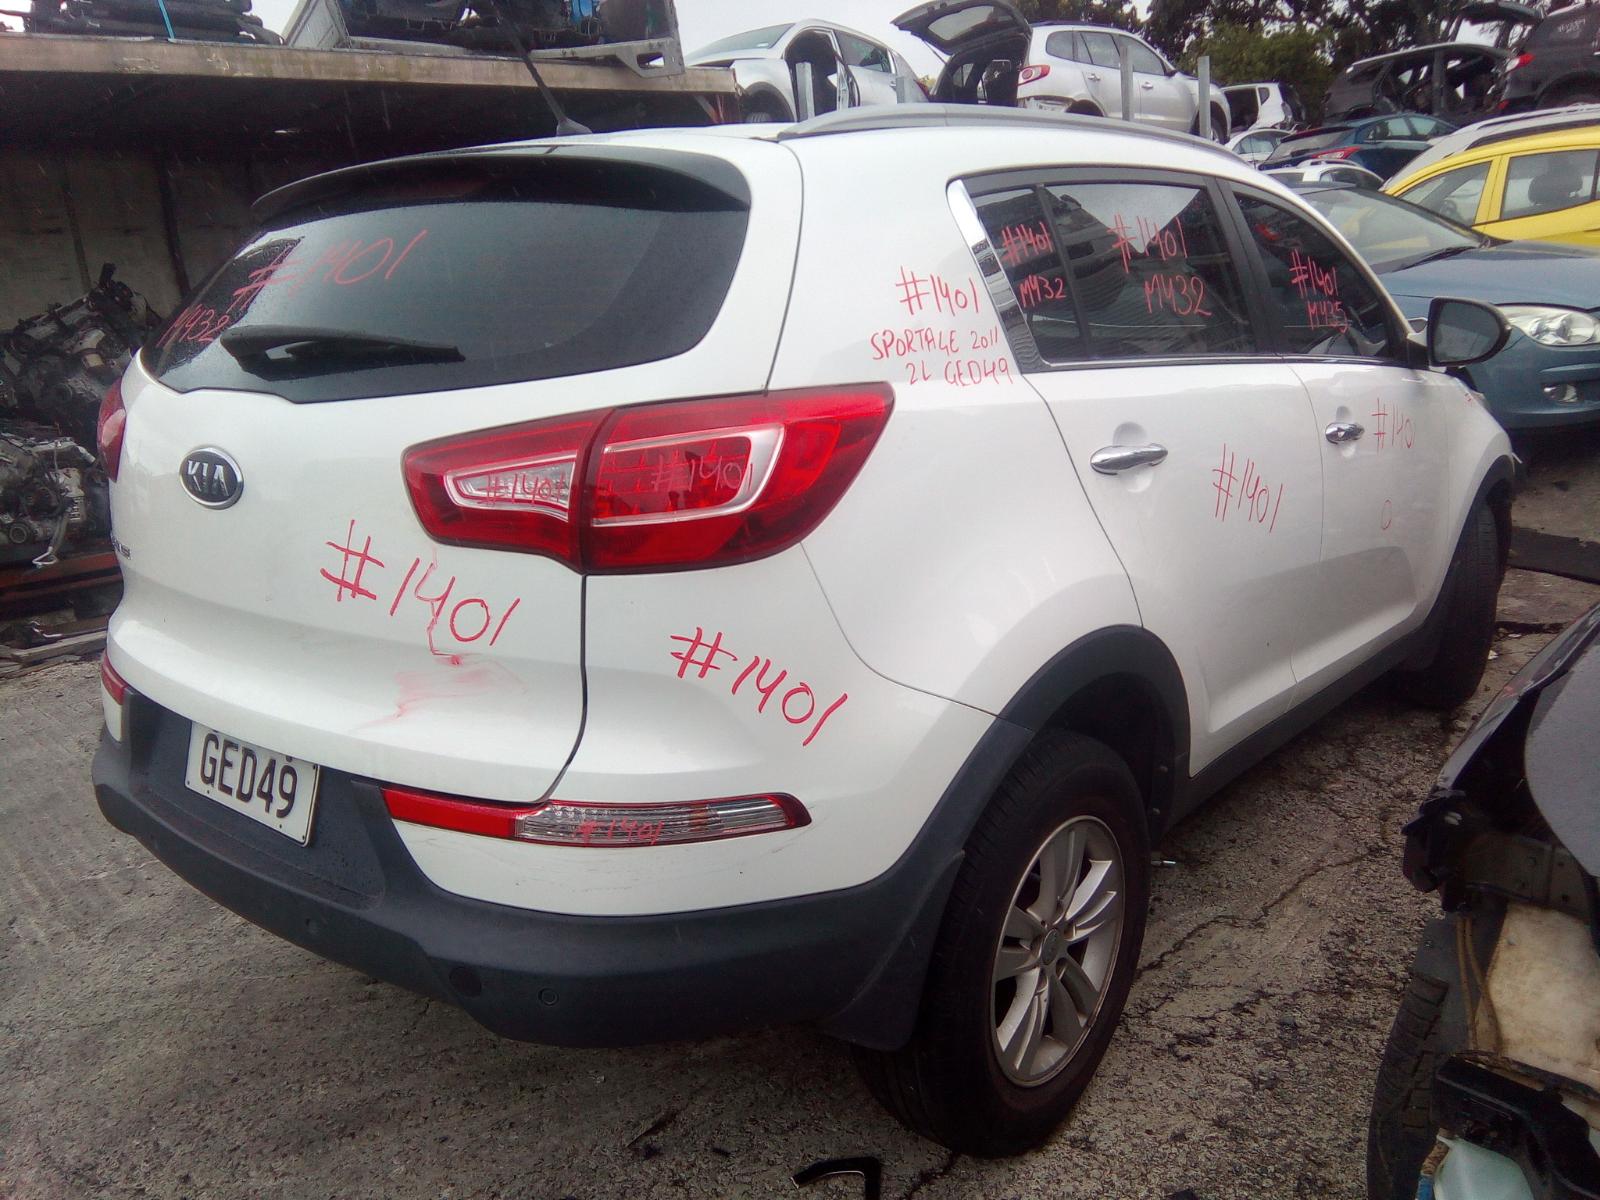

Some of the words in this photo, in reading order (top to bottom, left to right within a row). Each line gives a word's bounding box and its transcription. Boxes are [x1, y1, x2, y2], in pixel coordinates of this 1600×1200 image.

[1001, 221, 1053, 267] #1401
[1106, 212, 1188, 274] #1401
[895, 265, 980, 317] #1401
[1289, 248, 1339, 300] #1401
[970, 326, 999, 350] 2011
[943, 356, 1014, 388] GED49
[187, 460, 230, 497] KIA
[1212, 443, 1284, 534] #1401
[319, 519, 521, 647] #1401
[670, 627, 848, 746] #1401
[200, 732, 298, 819] GED49
